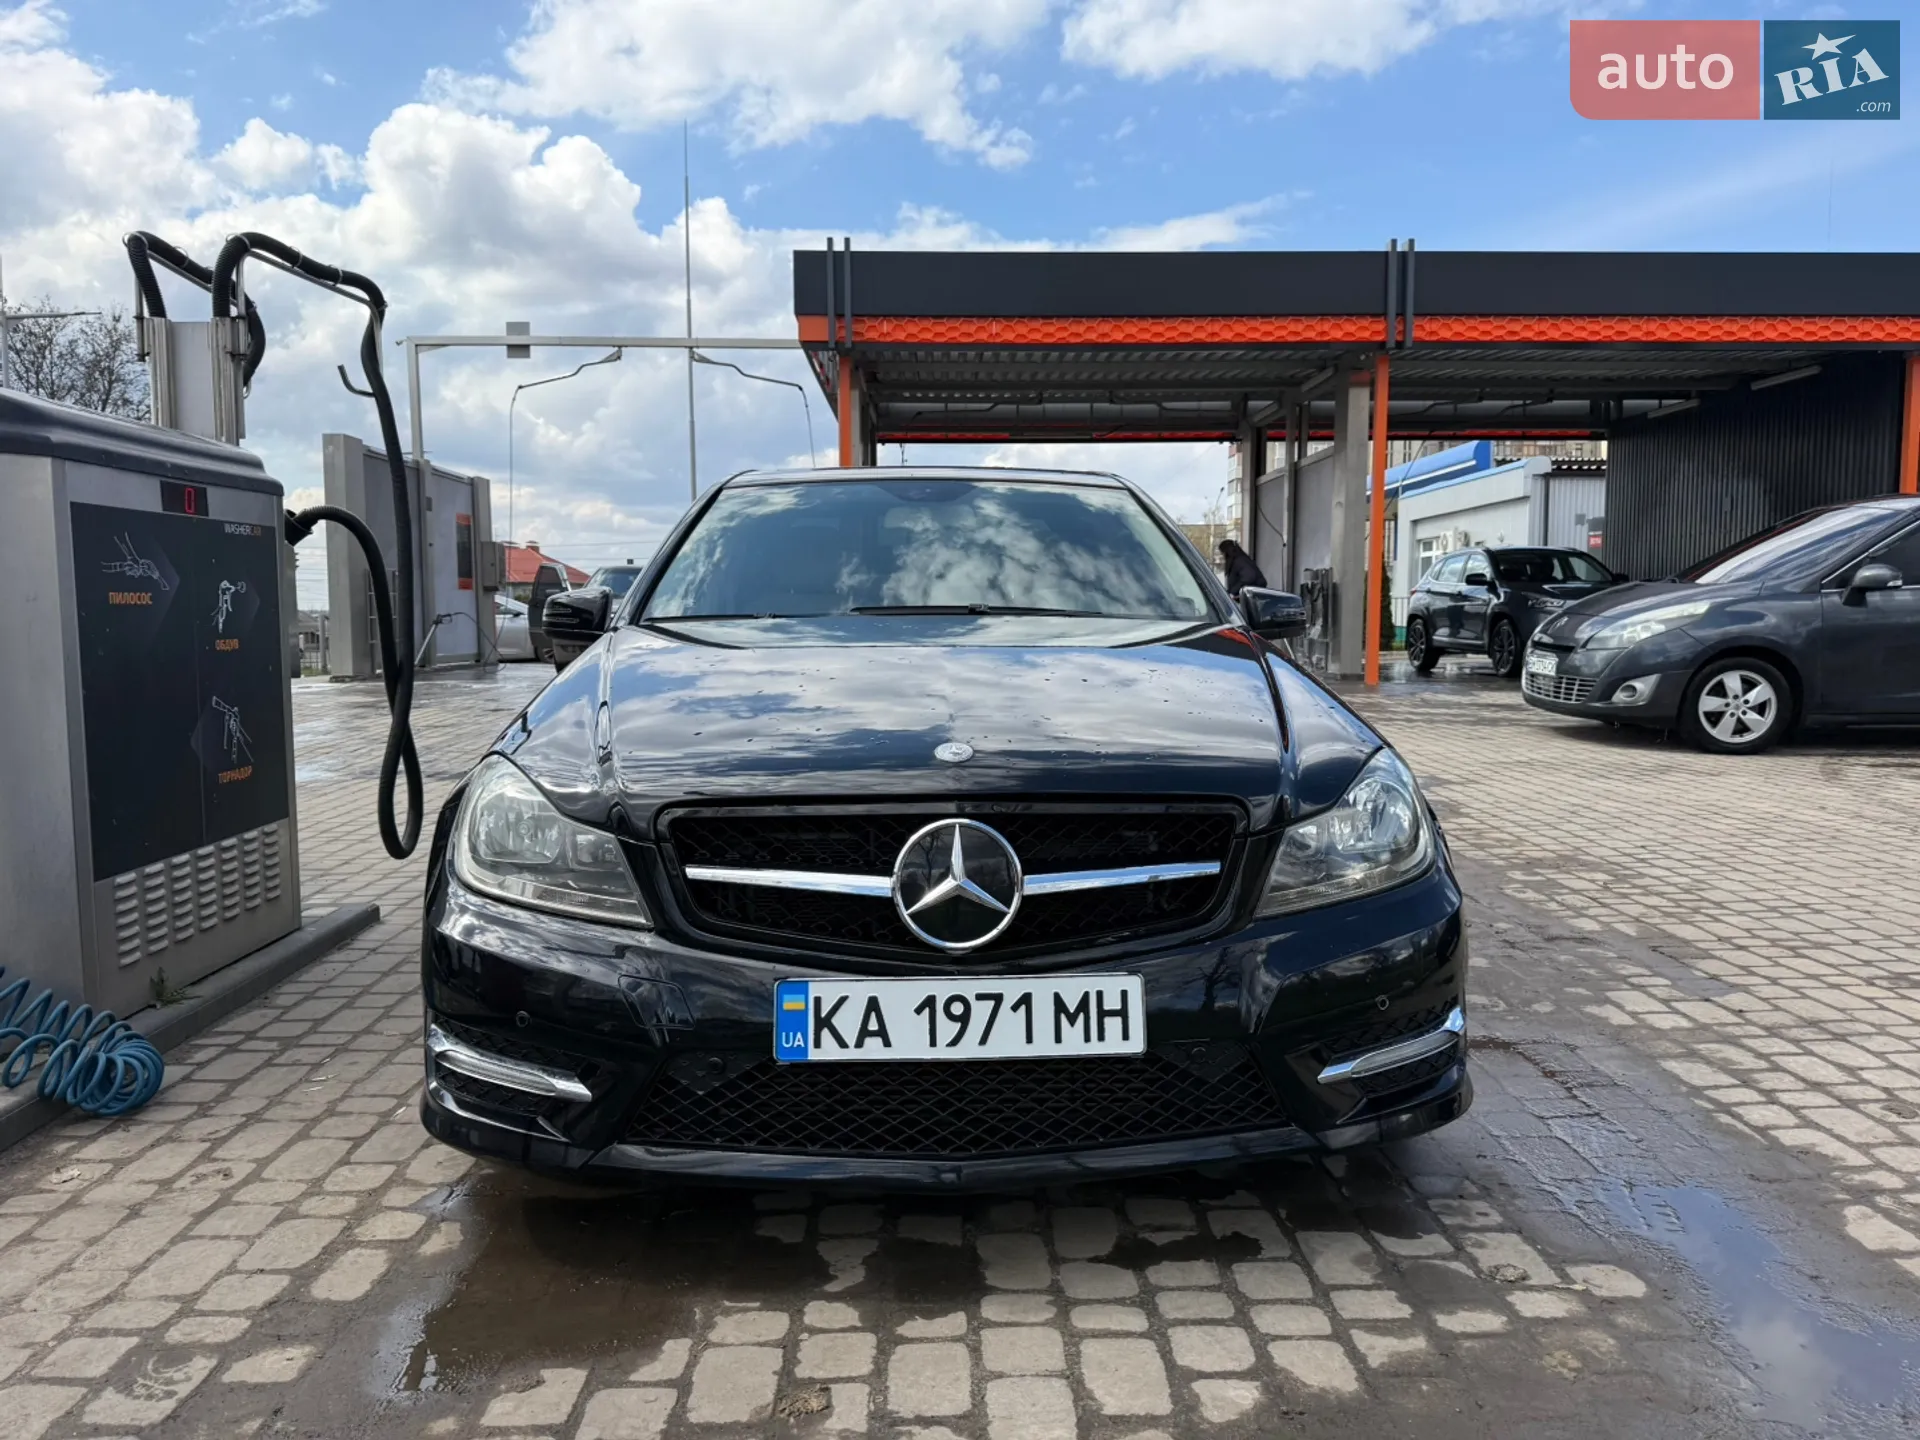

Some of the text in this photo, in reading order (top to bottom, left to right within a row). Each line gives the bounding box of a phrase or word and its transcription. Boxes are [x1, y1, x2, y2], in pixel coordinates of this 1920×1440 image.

[184, 487, 196, 514] 0
[108, 591, 154, 605] ПИЛОСОС
[812, 989, 1131, 1049] KA 1971 MH
[781, 1032, 805, 1049] UA
